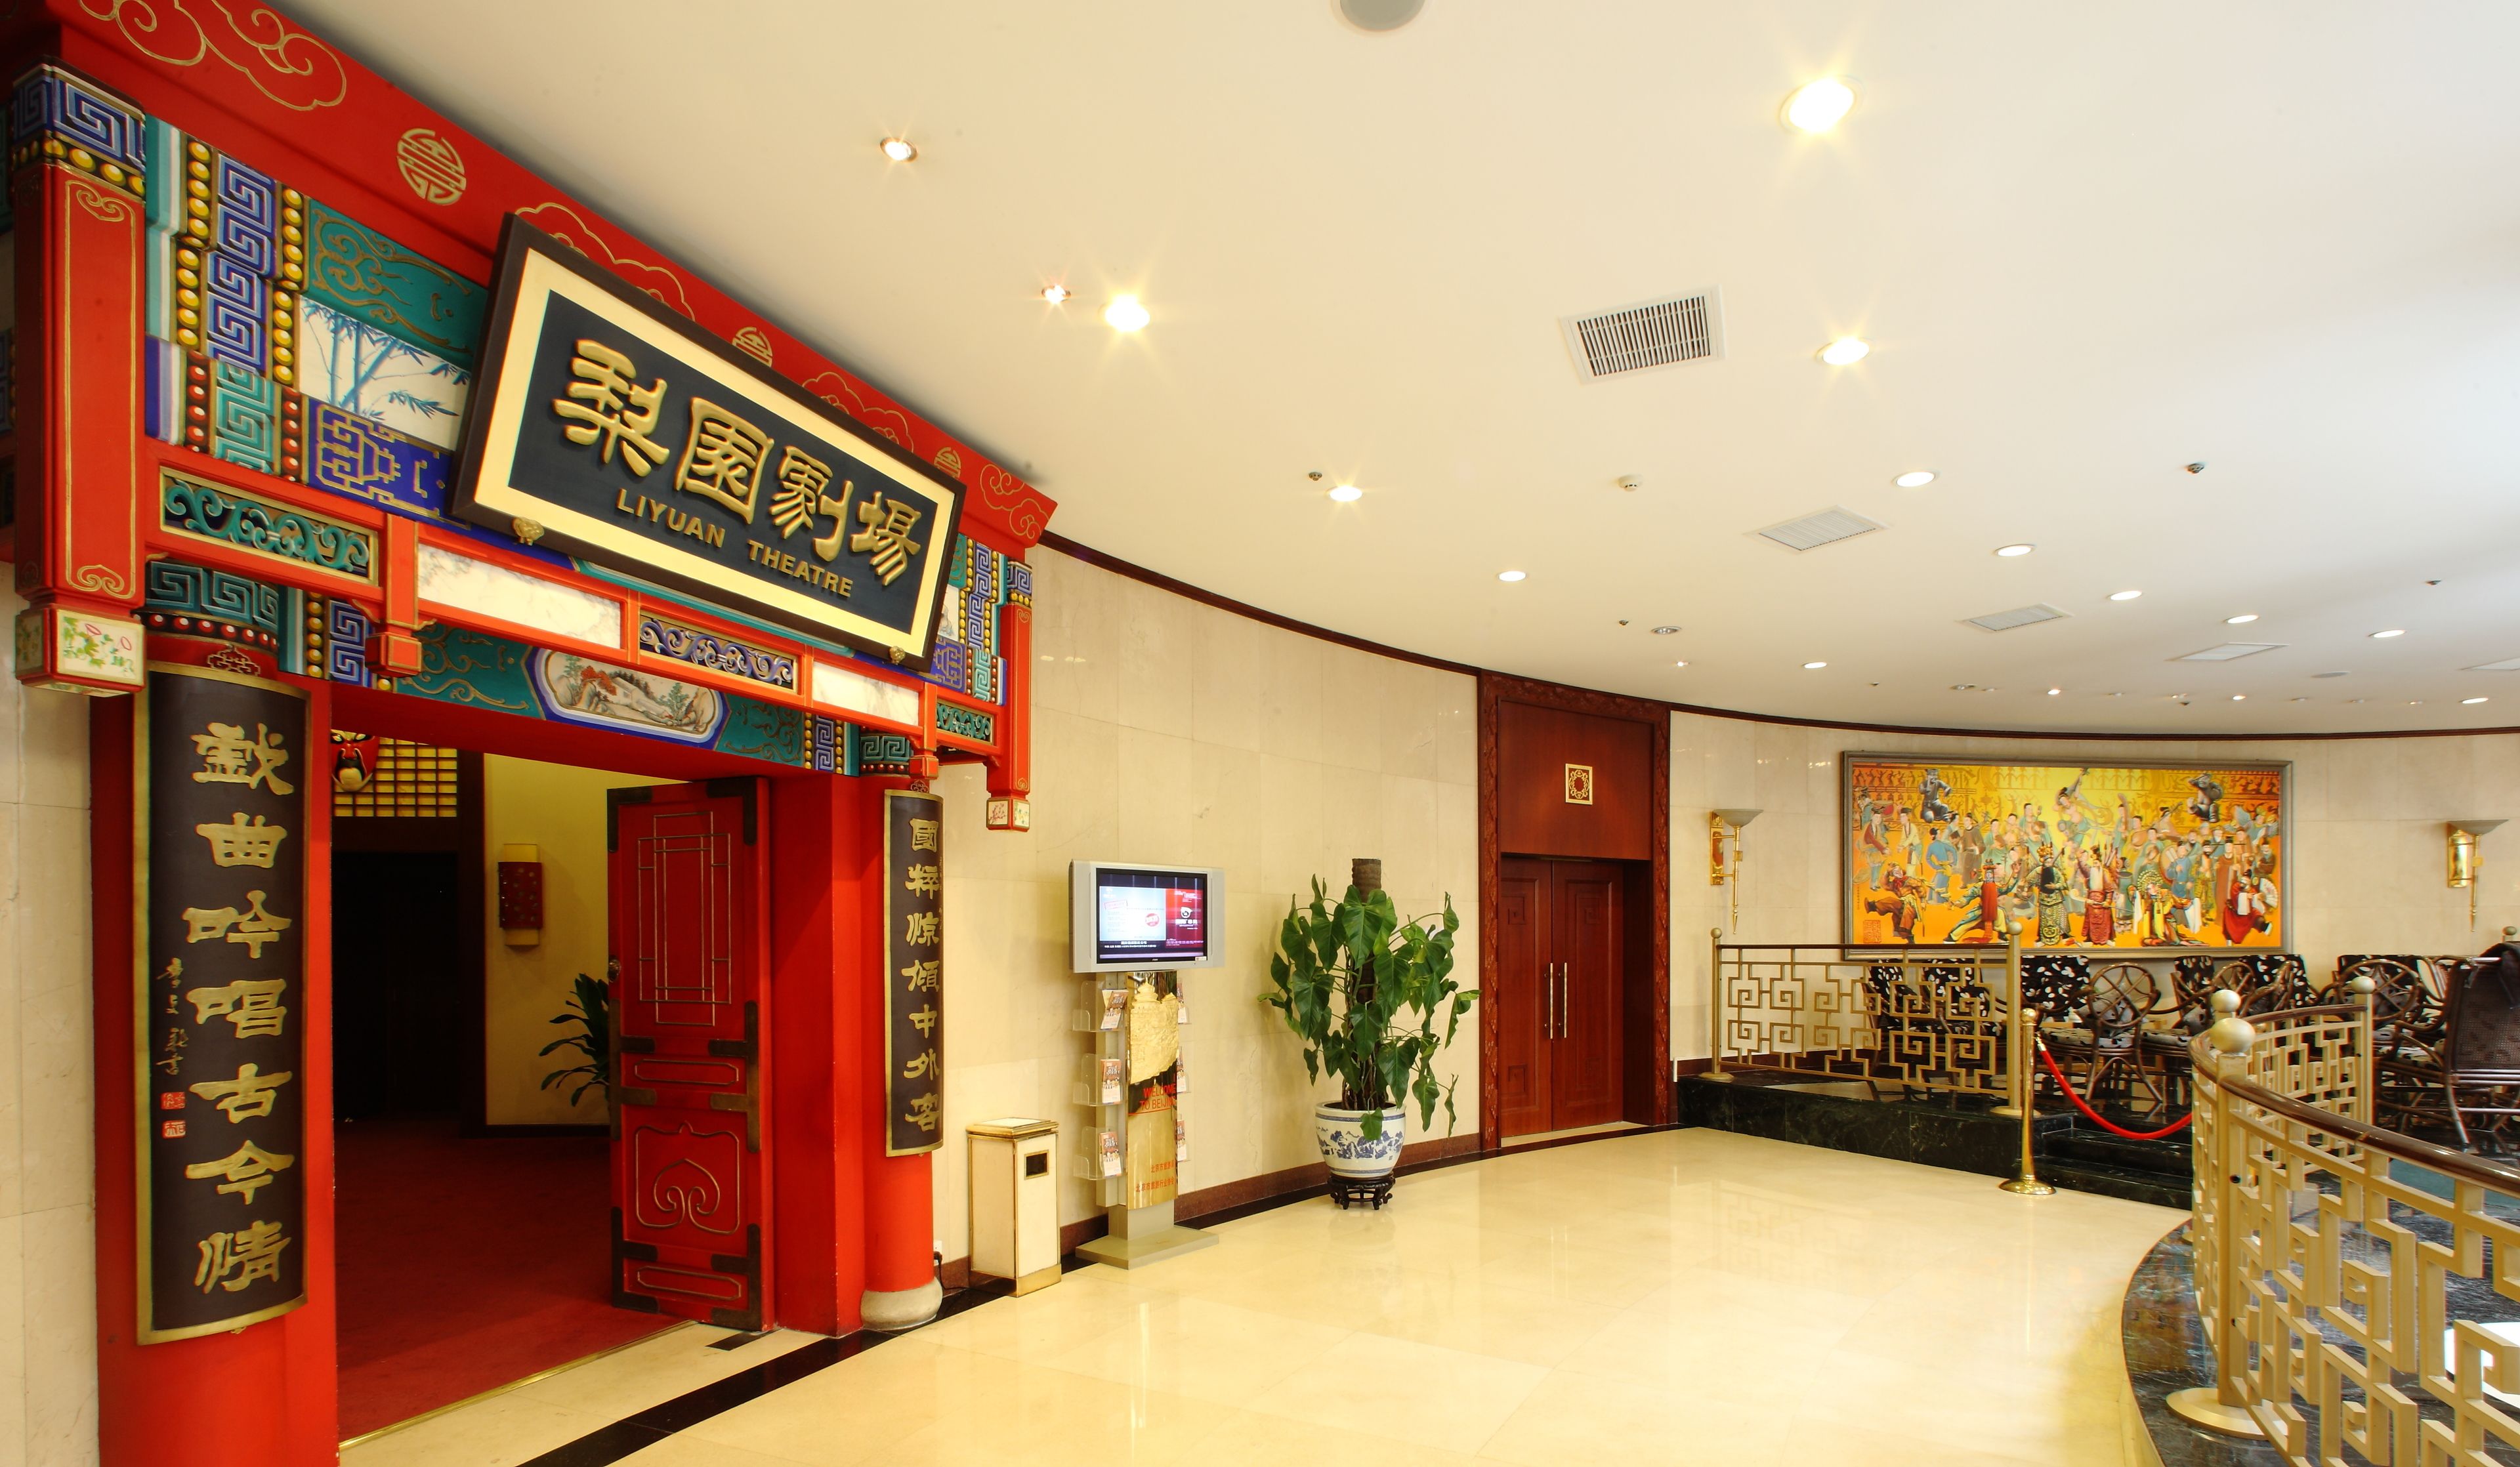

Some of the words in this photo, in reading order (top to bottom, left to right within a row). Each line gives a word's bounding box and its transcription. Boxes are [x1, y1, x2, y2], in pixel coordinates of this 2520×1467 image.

[616, 488, 726, 548] LIYUAN
[747, 539, 853, 598] THEATRE
[1139, 1100, 1150, 1110] TO
